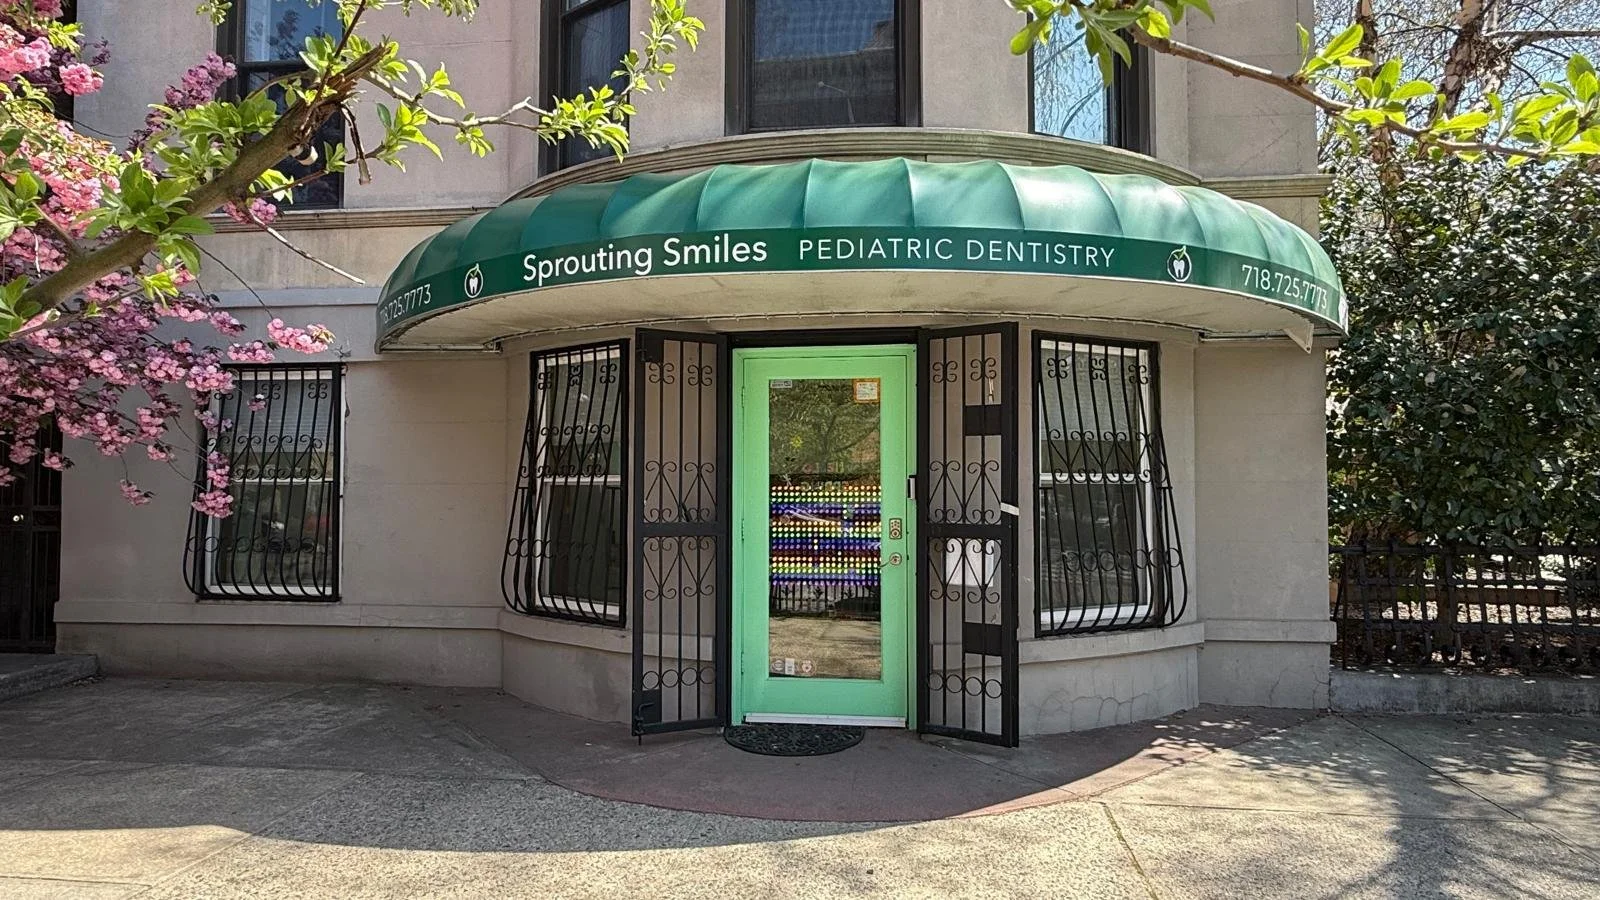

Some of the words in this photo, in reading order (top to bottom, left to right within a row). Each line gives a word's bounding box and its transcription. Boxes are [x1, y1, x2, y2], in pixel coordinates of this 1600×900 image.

[522, 243, 653, 286] Sprouting
[663, 233, 768, 266] Smiles
[799, 238, 953, 261] PEDIATRIC
[966, 240, 1115, 268] DENTISTRY
[380, 284, 431, 324] 78.725.7773
[1241, 264, 1327, 309] 718.725.7773
